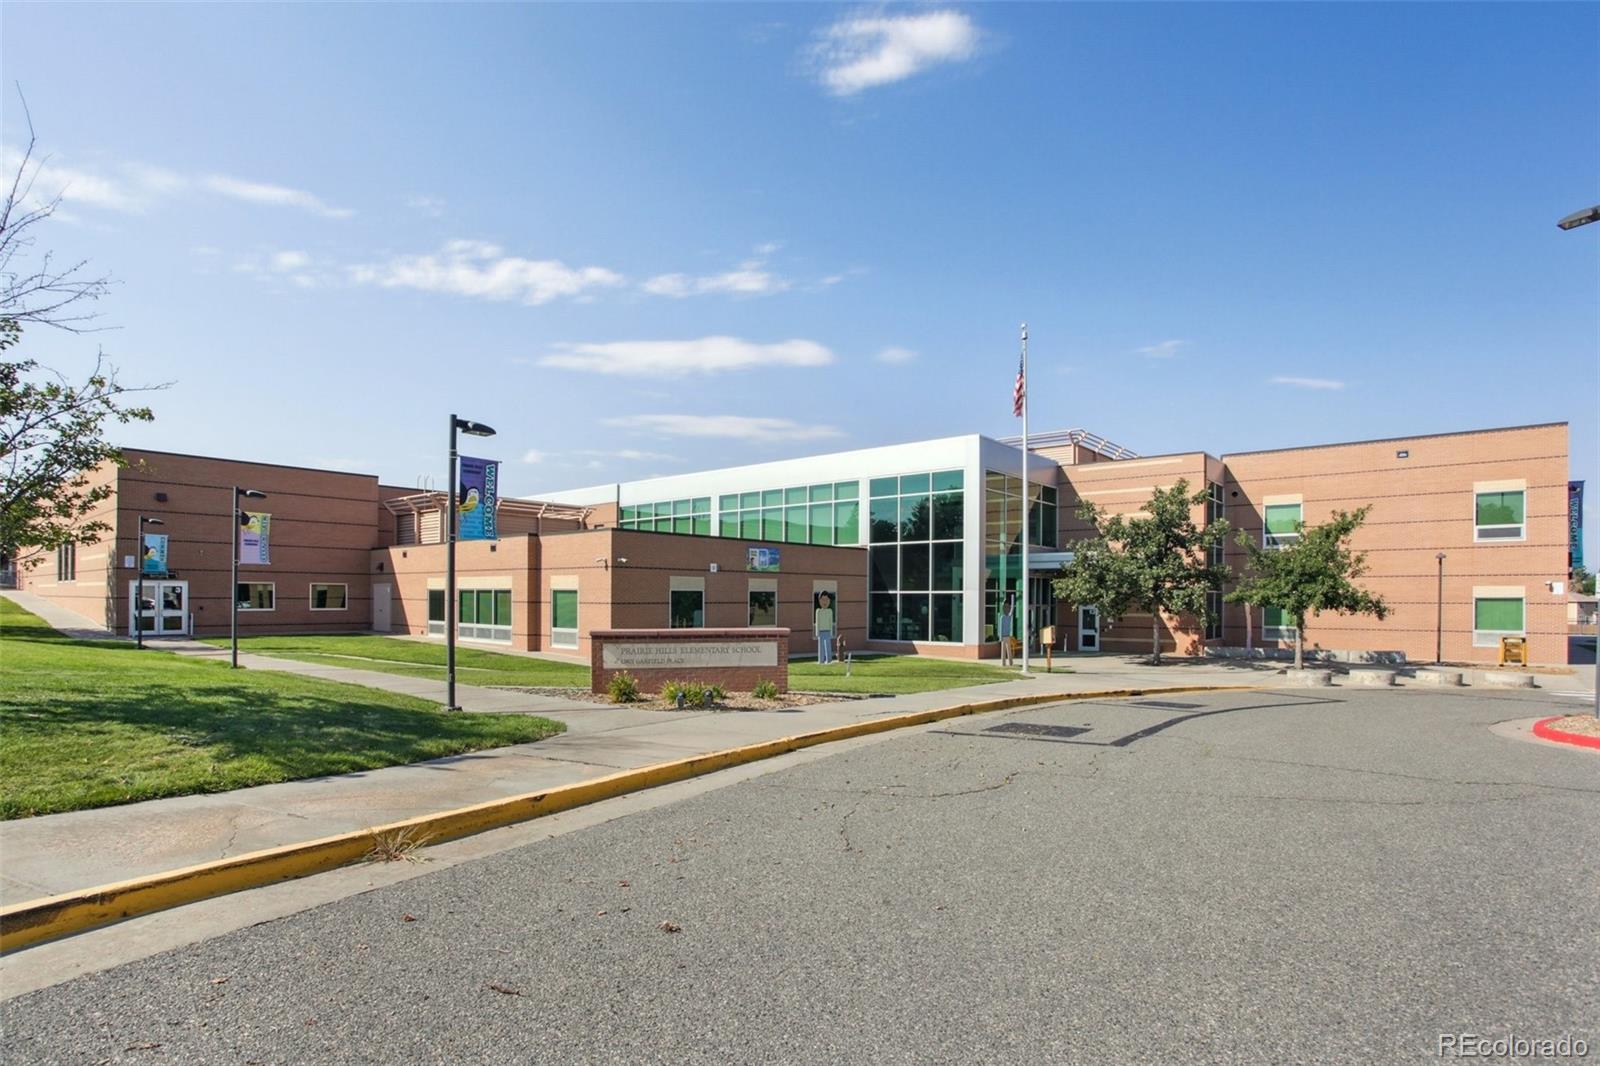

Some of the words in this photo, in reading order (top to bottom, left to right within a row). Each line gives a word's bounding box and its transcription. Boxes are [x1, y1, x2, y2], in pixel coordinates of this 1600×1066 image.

[484, 464, 496, 537] WELCOME
[621, 647, 653, 655] PRAIRIE
[655, 647, 677, 655] HILLS
[680, 646, 729, 654] ELEMENTARY
[732, 645, 761, 653] SCHOOL
